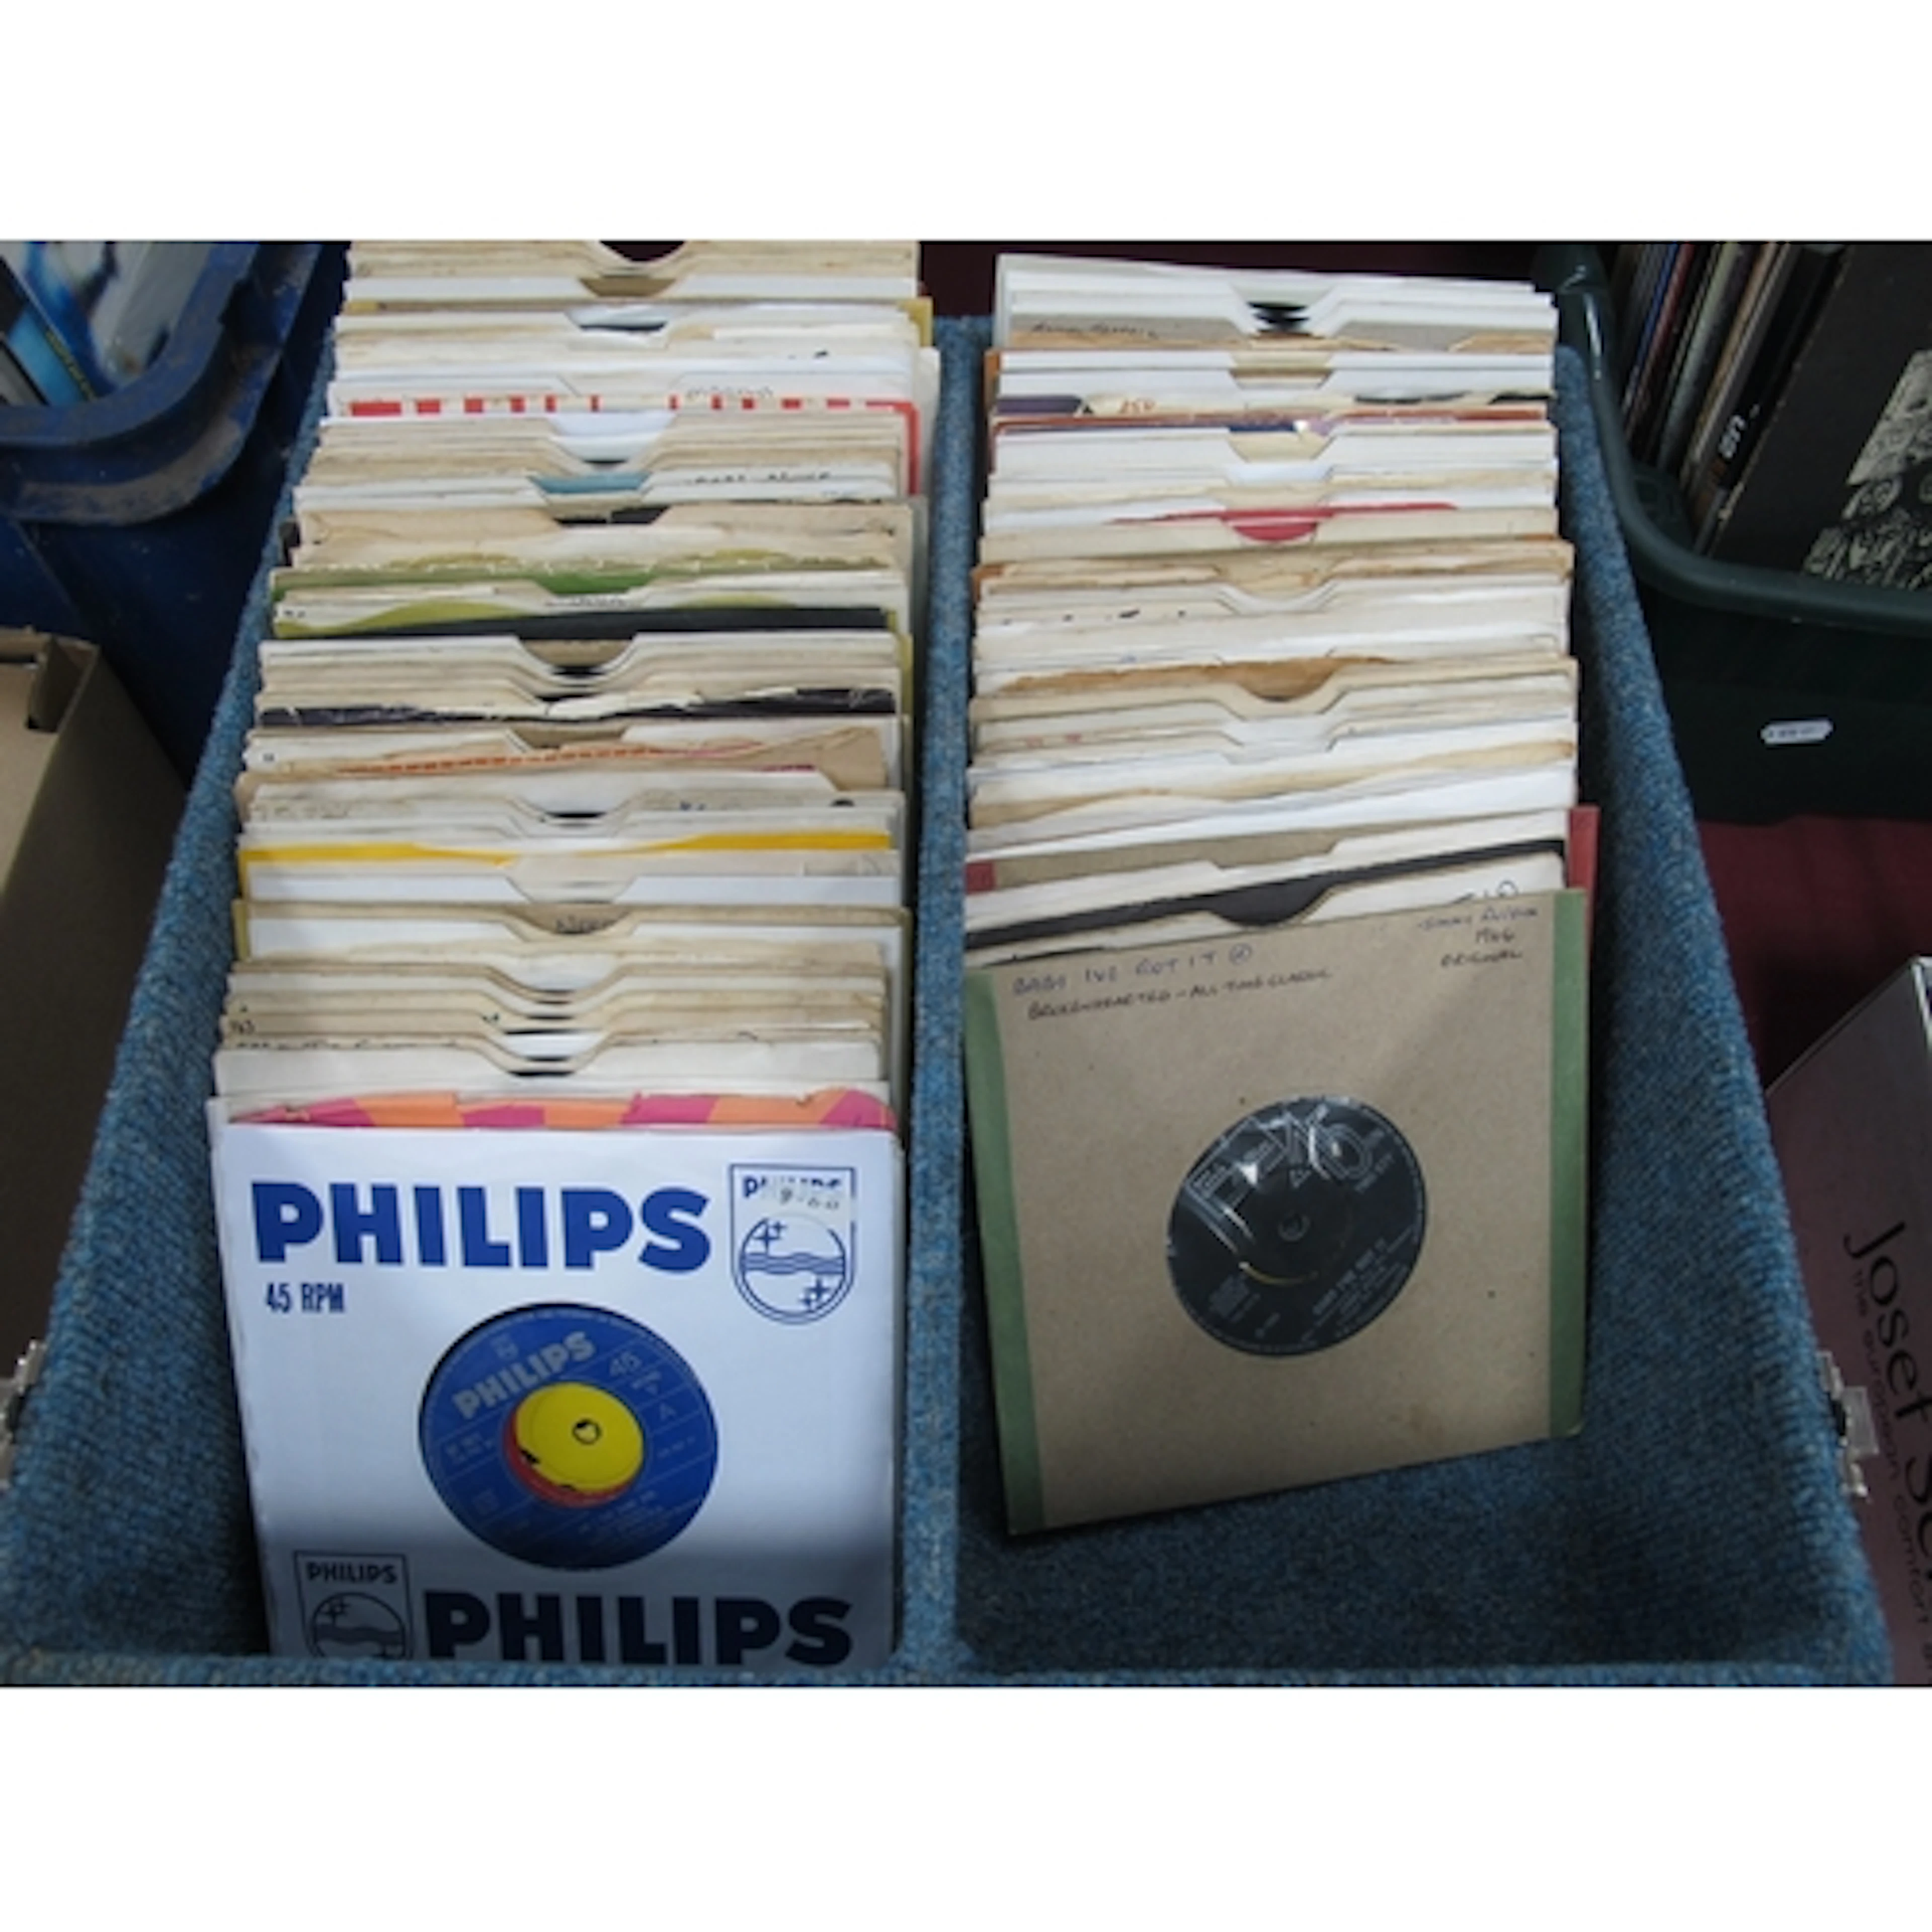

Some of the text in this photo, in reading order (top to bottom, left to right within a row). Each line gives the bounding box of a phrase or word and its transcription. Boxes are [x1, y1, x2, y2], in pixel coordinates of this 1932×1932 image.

[251, 1180, 711, 1273] PHILIPS
[266, 1282, 344, 1313] 45 RPM
[452, 1330, 597, 1420] PHILIPS
[306, 1561, 397, 1585] PHILIPS
[423, 1589, 853, 1667] PHILIPS
